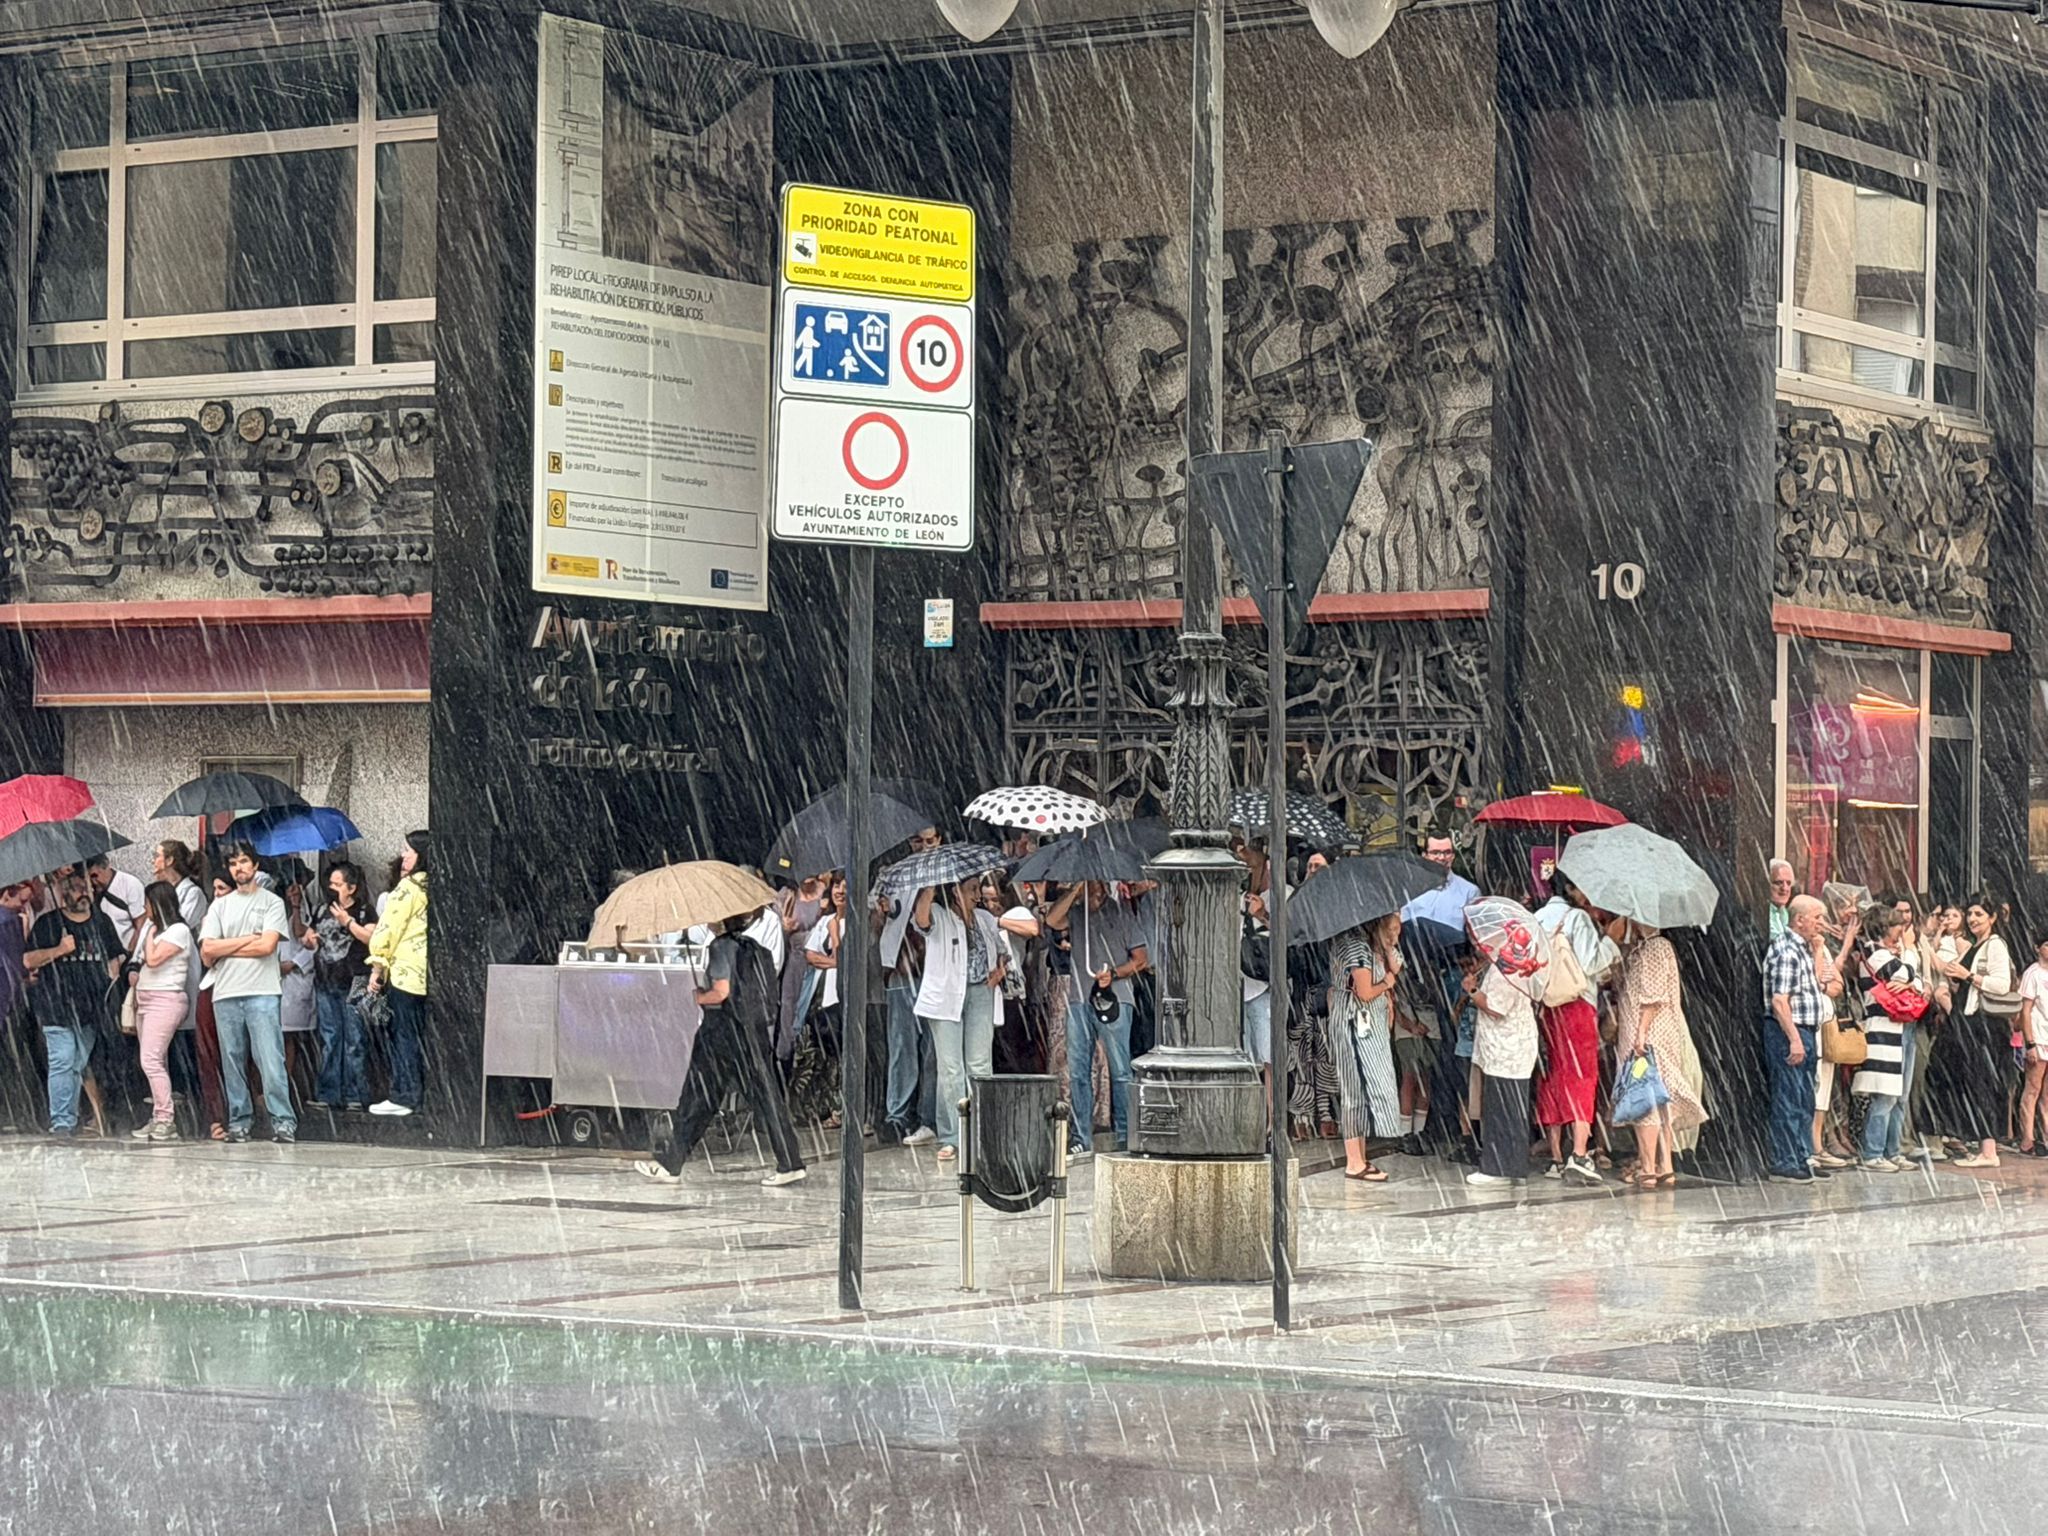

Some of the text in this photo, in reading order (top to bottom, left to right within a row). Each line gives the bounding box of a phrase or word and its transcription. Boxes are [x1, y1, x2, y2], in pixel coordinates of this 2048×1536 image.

[843, 201, 919, 224] ZONA CON
[801, 214, 958, 246] PRIORIDAD PEATONAL
[820, 243, 968, 270] VIDEOVIGILANCIA DE TRÁFICO
[550, 264, 573, 280] PIREP
[602, 275, 649, 293] PROGRAMA
[649, 283, 661, 296] DE
[662, 285, 697, 303] IMPULSO
[793, 266, 827, 278] CONTROL
[830, 270, 839, 279] DE
[881, 276, 916, 287] DENUNCIA
[550, 283, 704, 321] REHABILITACIÓN DE EDIFICIOS PÚBLICOS
[917, 339, 947, 367] 10
[552, 454, 561, 472] R
[844, 493, 905, 509] EXCEPTO
[788, 503, 959, 527] VEHÍCULOS AUTORIZADOS
[802, 522, 945, 541] AYUNTAMIENTO DE LEÓN
[1591, 562, 1646, 600] 10
